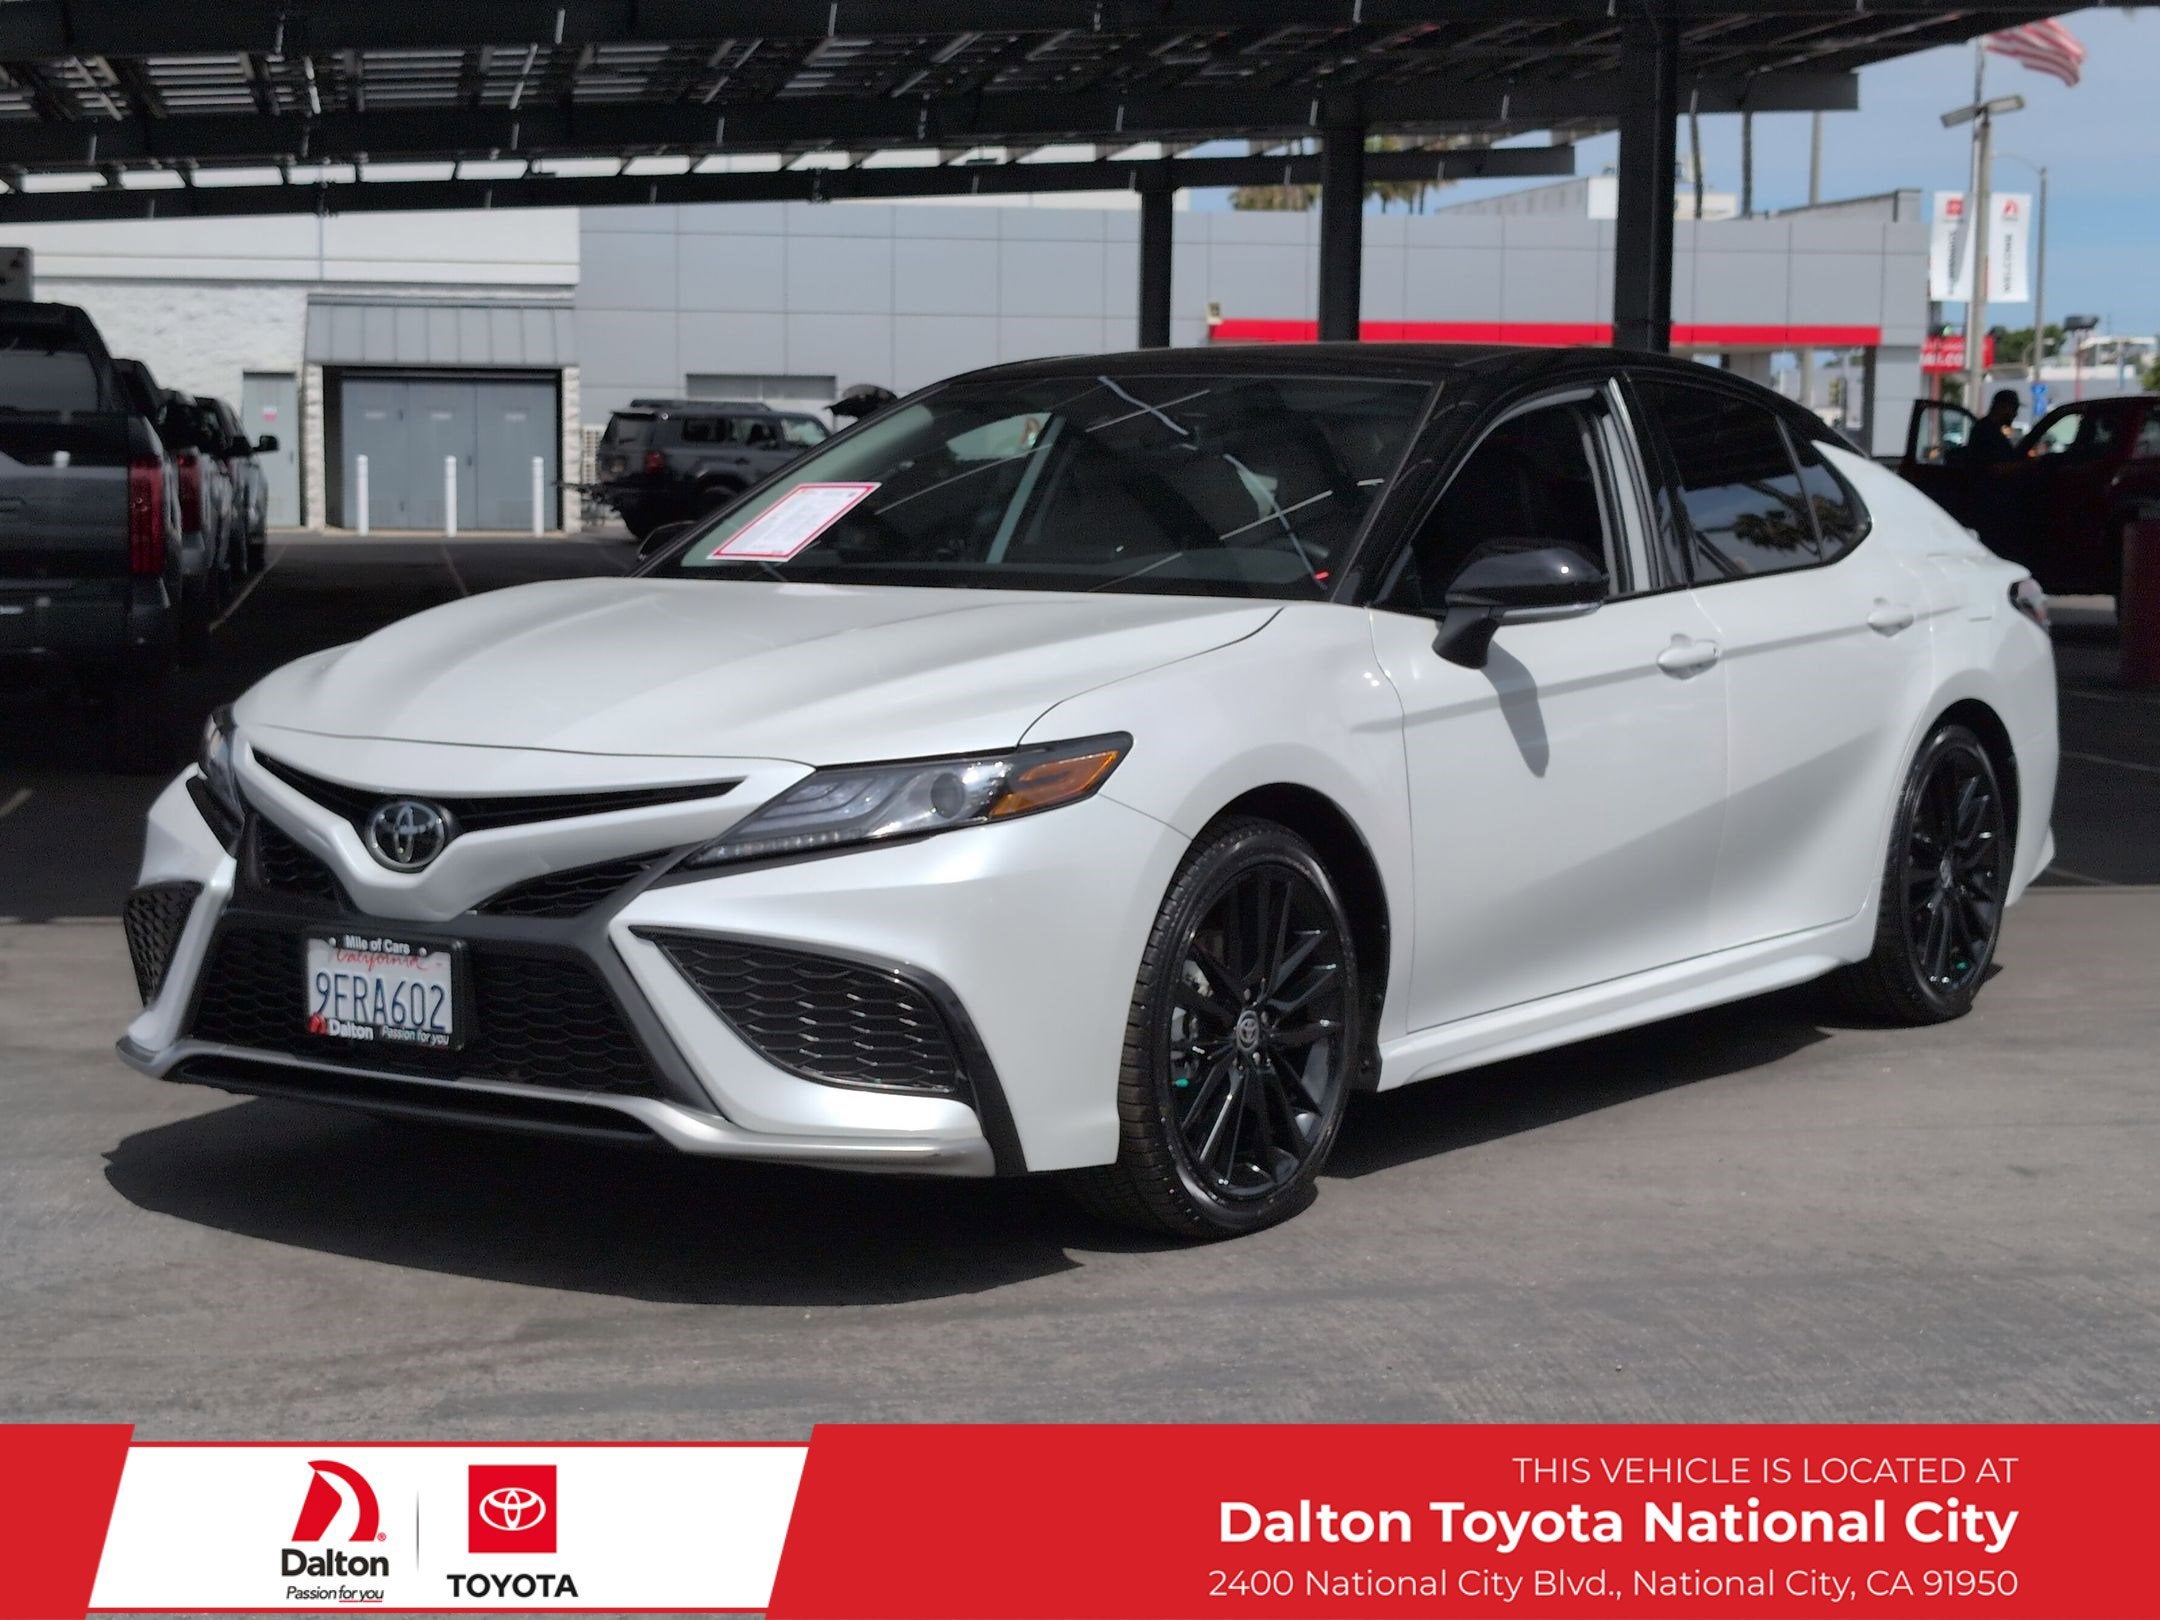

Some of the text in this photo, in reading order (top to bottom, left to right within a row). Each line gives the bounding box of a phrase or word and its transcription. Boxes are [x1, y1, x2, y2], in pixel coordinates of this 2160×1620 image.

[344, 934, 411, 956] Mile of Cars
[328, 1018, 450, 1046] Dalton Passion for you
